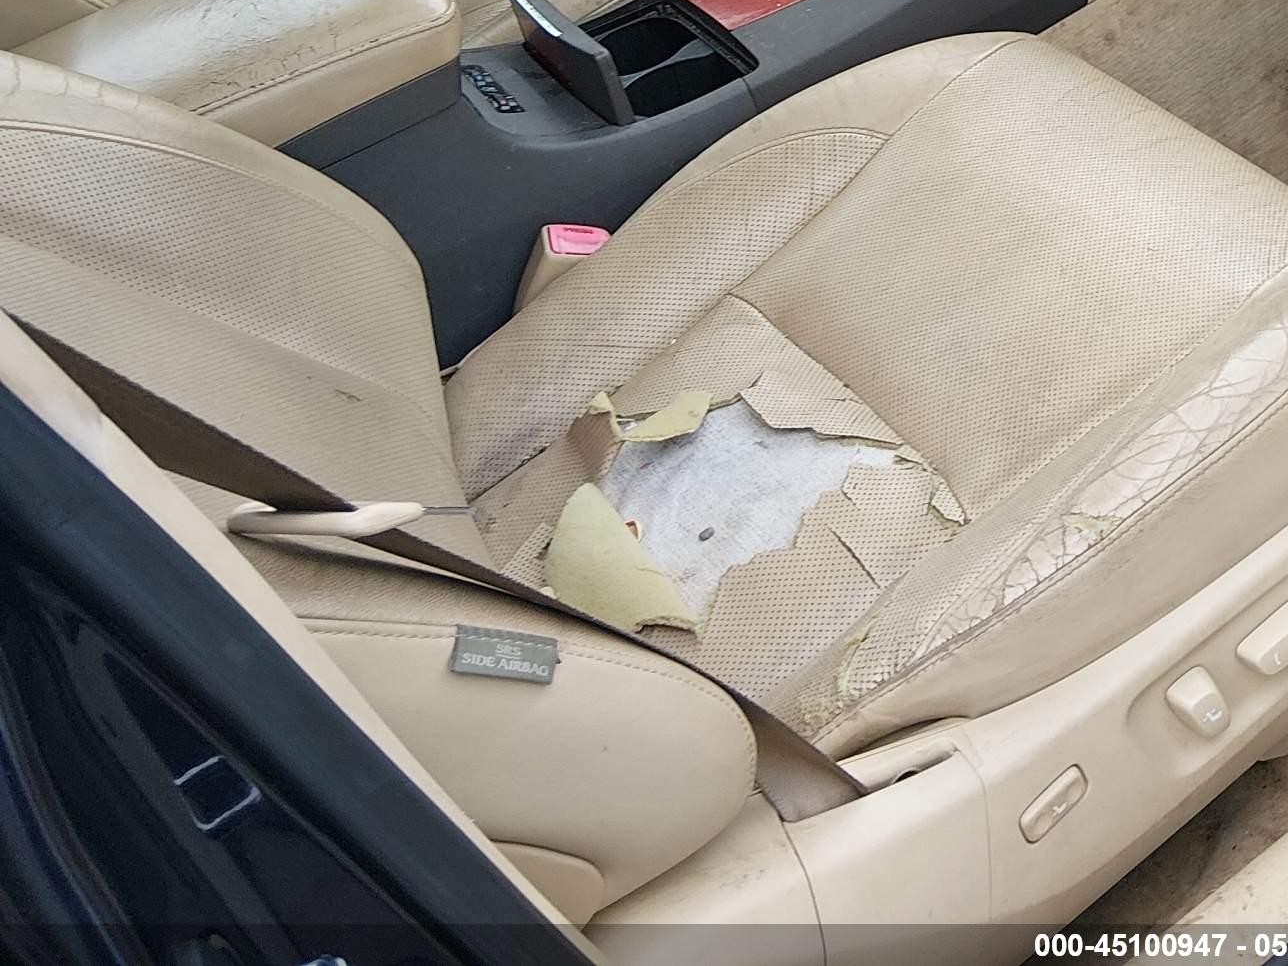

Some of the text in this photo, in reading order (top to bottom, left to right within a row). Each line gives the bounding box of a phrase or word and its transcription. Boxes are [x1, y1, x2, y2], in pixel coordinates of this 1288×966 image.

[495, 644, 521, 655] SRS
[461, 653, 549, 676] SIDE AIRBAG
